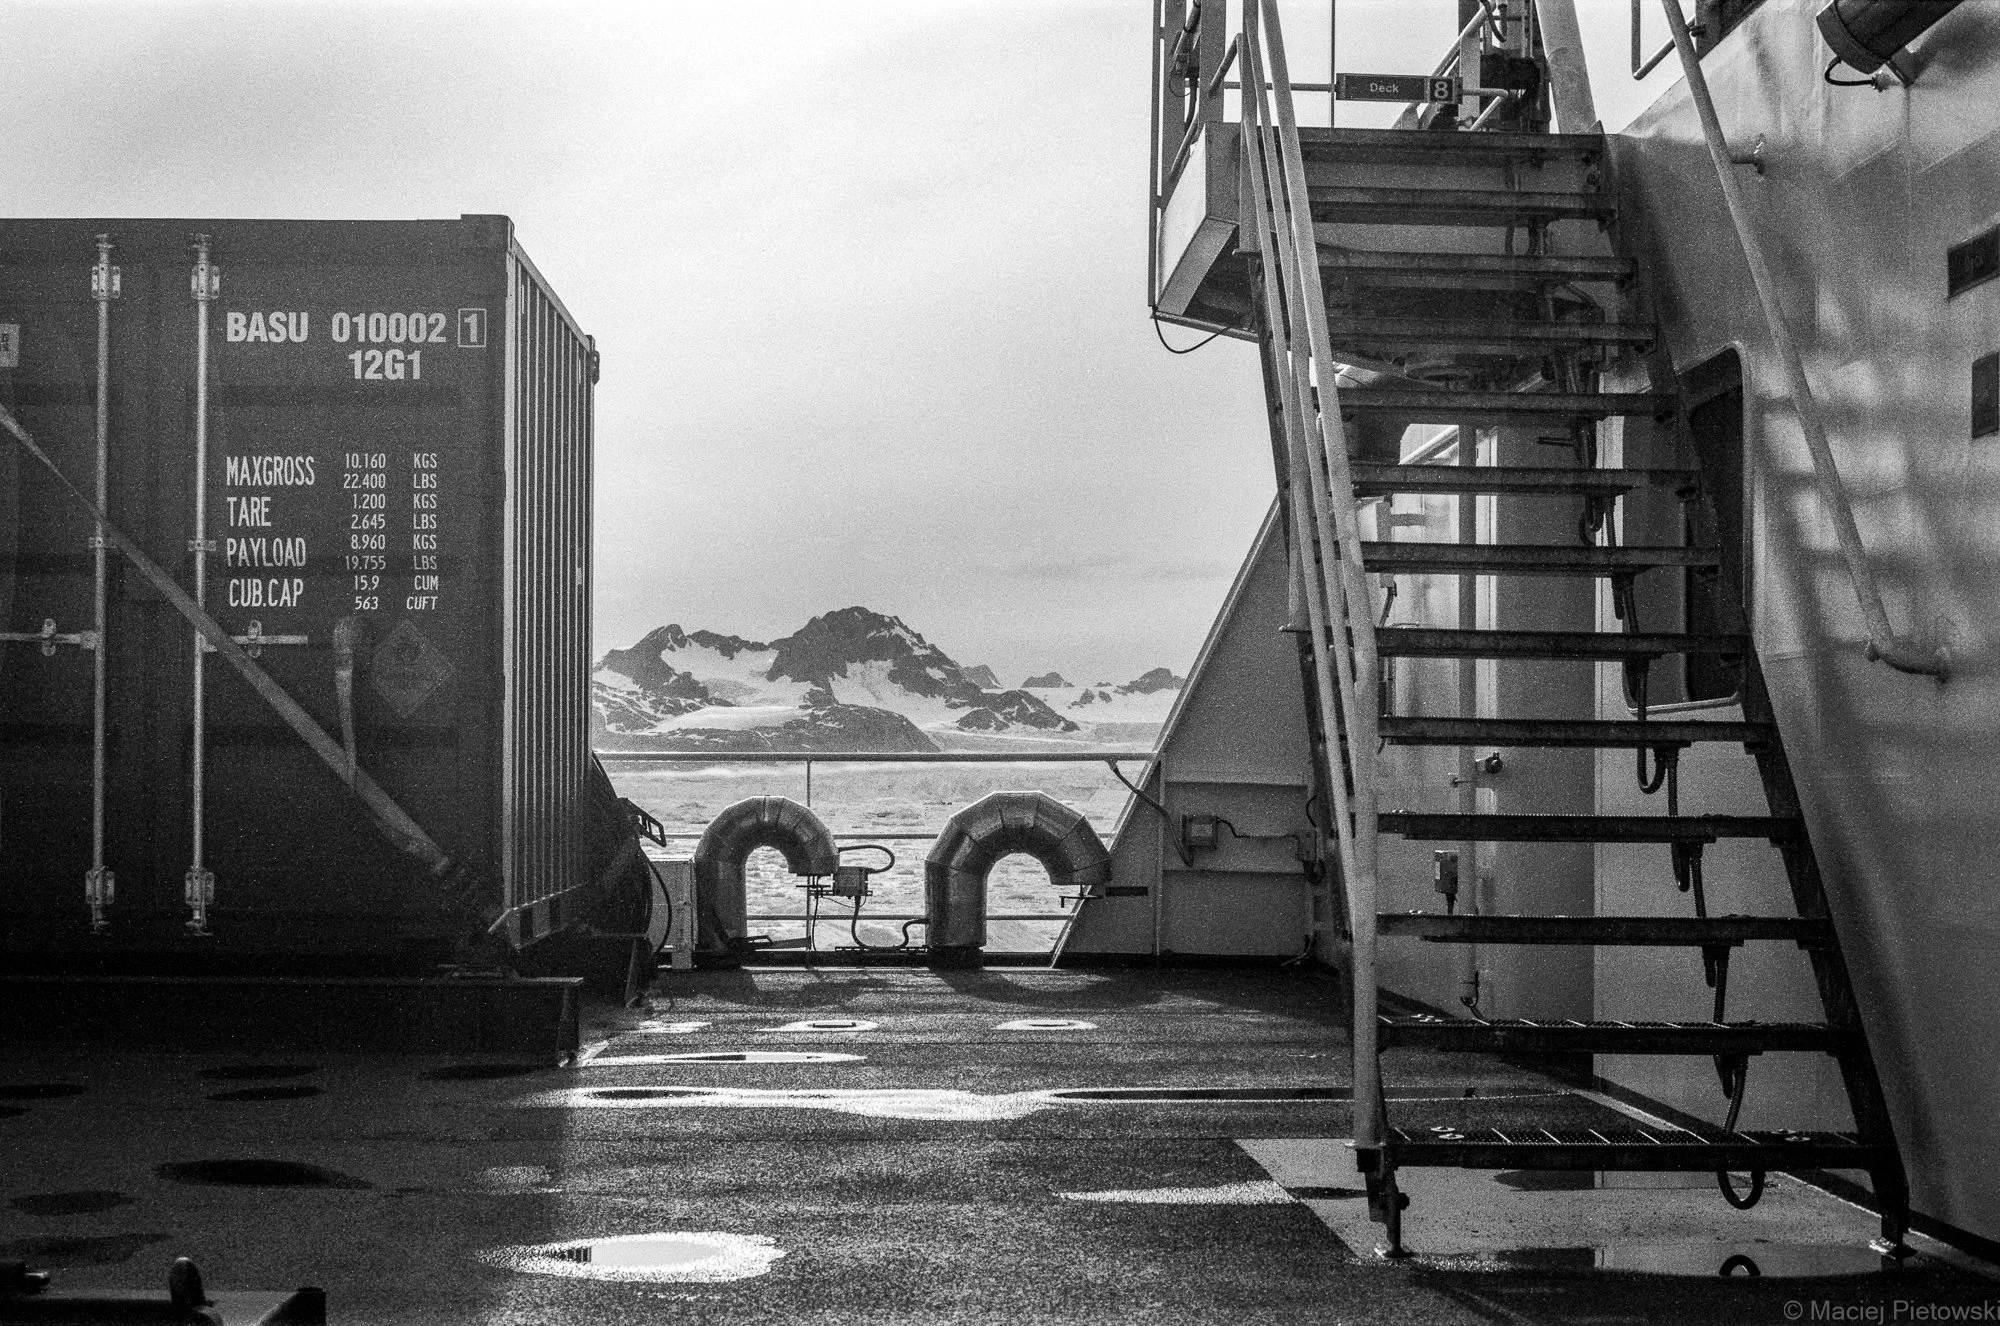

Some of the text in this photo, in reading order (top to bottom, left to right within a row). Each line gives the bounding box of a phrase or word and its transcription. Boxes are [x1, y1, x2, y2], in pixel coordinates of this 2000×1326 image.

[1369, 81, 1449, 99] Deck 8
[227, 312, 478, 343] BASU 010002 1
[349, 350, 421, 380] 12G1
[226, 453, 438, 486] MAXGROSS 10.160 KGS
[343, 473, 438, 489] 22.400 LBS
[227, 496, 272, 527] TARE
[413, 494, 438, 509] KGS
[351, 514, 438, 530] 2.645 LBS
[226, 537, 307, 567] PAYLOAD
[413, 534, 437, 550] KGS
[345, 555, 438, 571] 19.755 LBS
[229, 575, 439, 607] CUB.CAP 15.9 CUM
[354, 596, 439, 610] 563 CUFT
